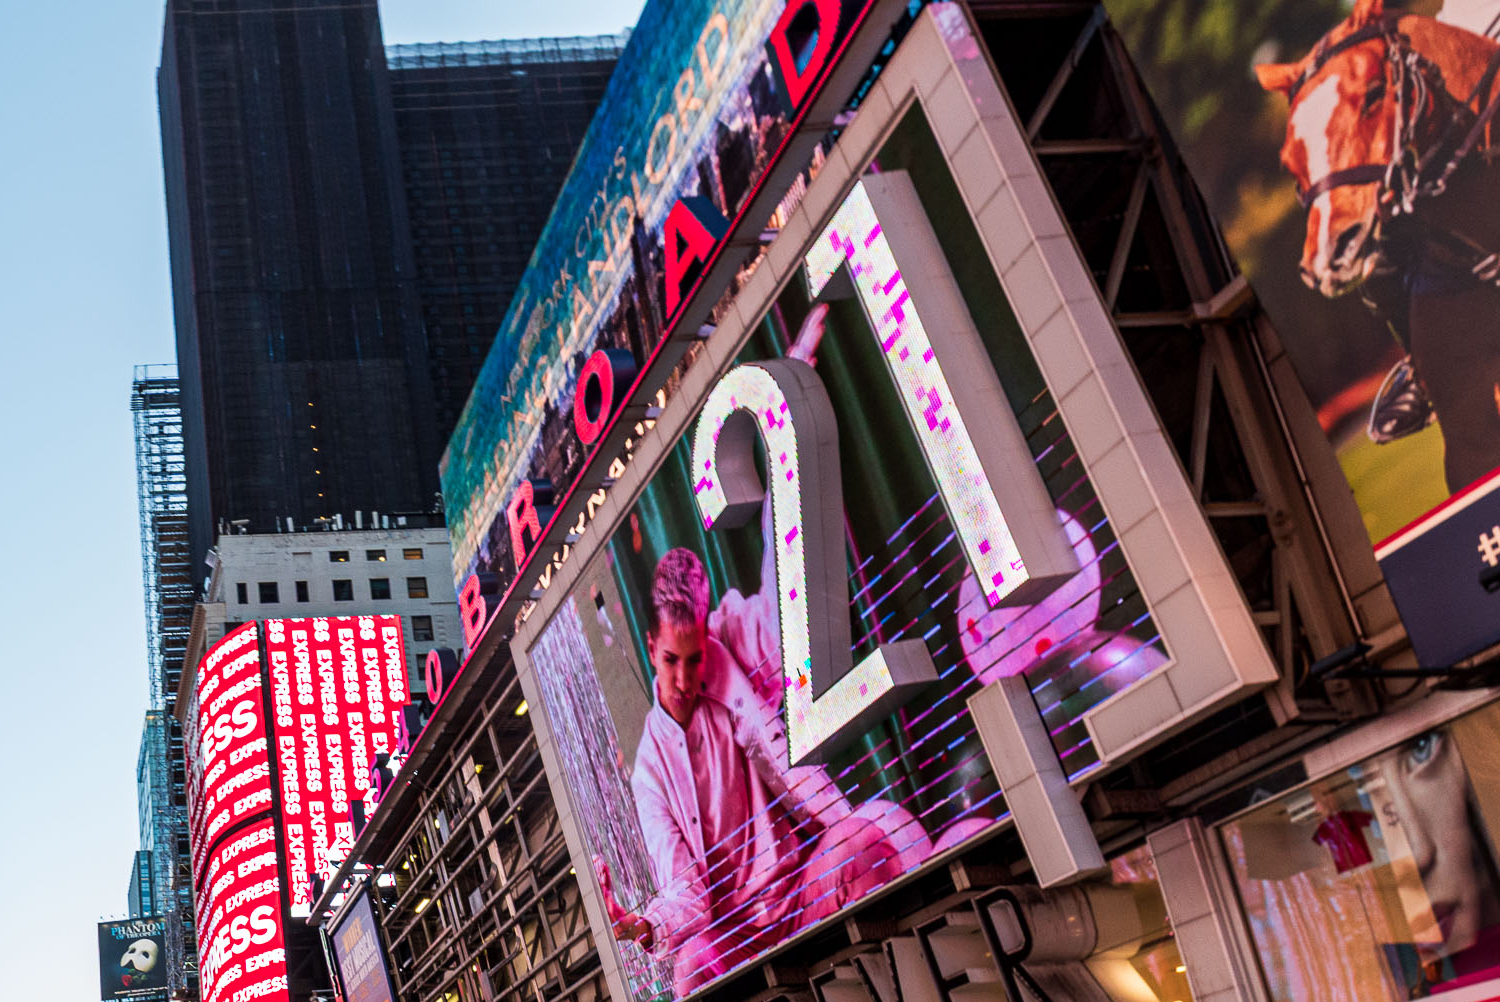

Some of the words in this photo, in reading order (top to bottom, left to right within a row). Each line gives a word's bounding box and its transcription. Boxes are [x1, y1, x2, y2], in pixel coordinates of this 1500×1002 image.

[546, 6, 755, 365] LANDLORD
[693, 175, 1045, 767] 21
[271, 650, 293, 728] EXPRESS
[291, 629, 315, 706] EXPRESS
[316, 649, 339, 726] EXPRESS
[337, 628, 361, 704] EXPRESS
[362, 647, 386, 724] EXPRESS
[381, 626, 406, 703] EXPRESS
[279, 735, 301, 815] EXPRESS
[300, 713, 323, 793] EXPRESS
[325, 733, 349, 814] EXPRESS
[347, 711, 371, 791] EXPRESS
[287, 823, 311, 906] EXPRESS
[111, 922, 165, 936] PHANTOM
[201, 905, 277, 1001] EXPRESS
